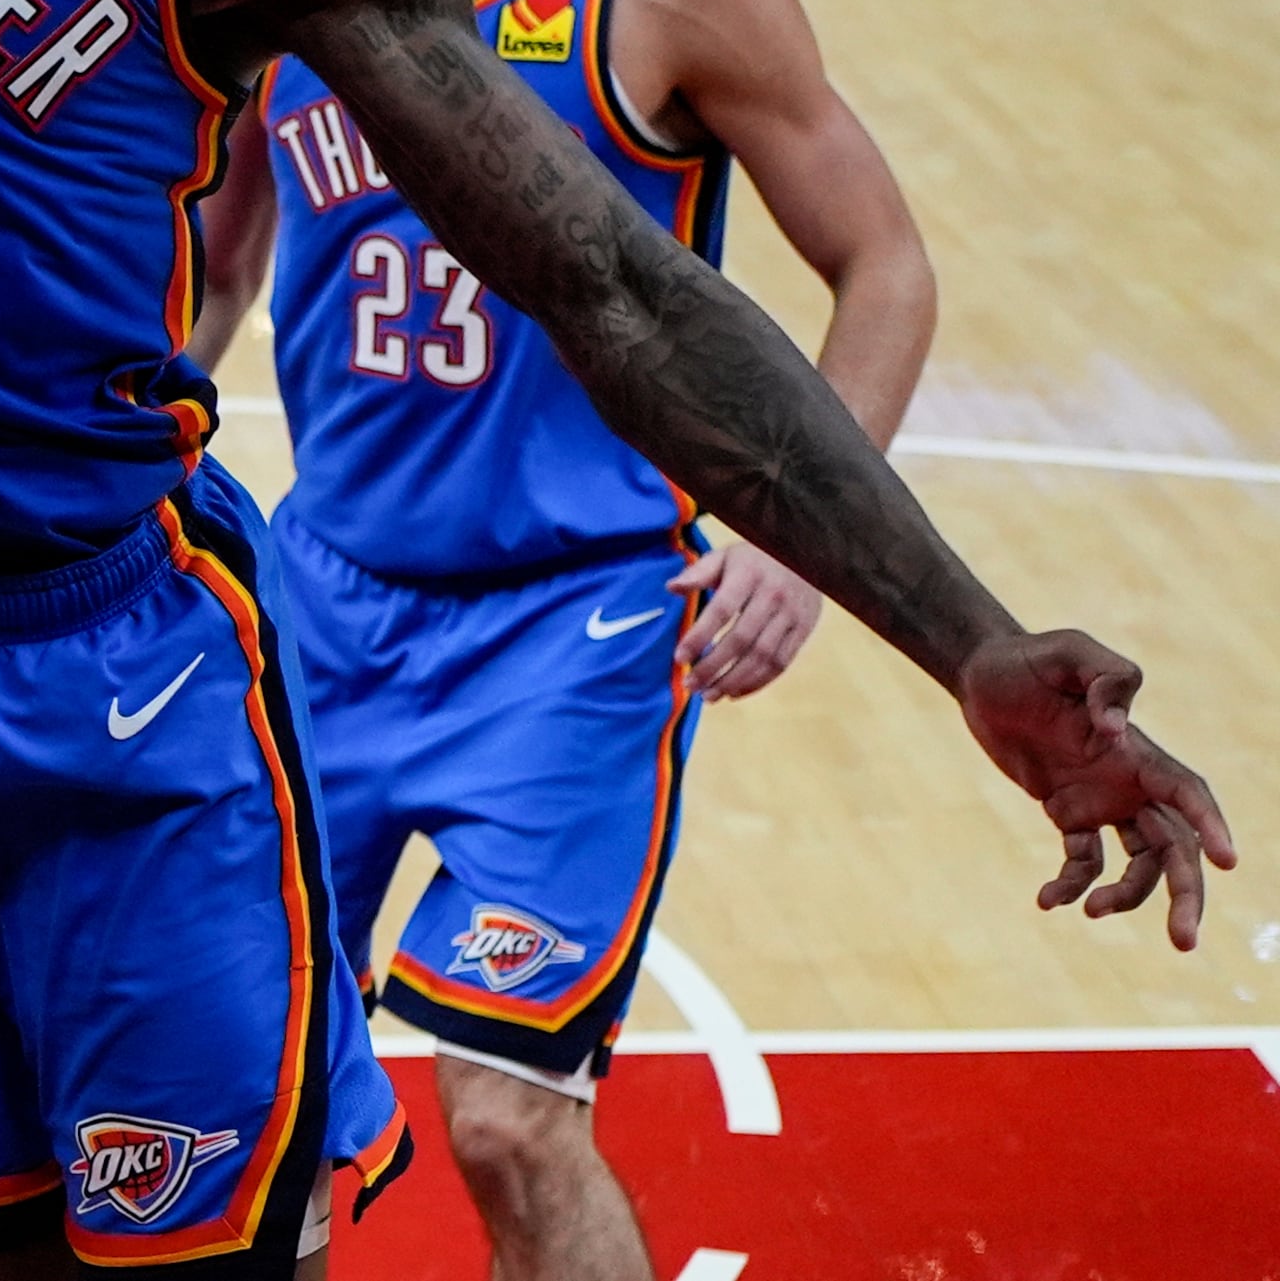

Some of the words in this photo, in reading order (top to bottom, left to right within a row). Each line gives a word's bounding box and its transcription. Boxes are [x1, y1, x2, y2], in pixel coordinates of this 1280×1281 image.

[350, 234, 493, 387] 23
[462, 928, 538, 961] OKC
[88, 1140, 164, 1194] OKC
